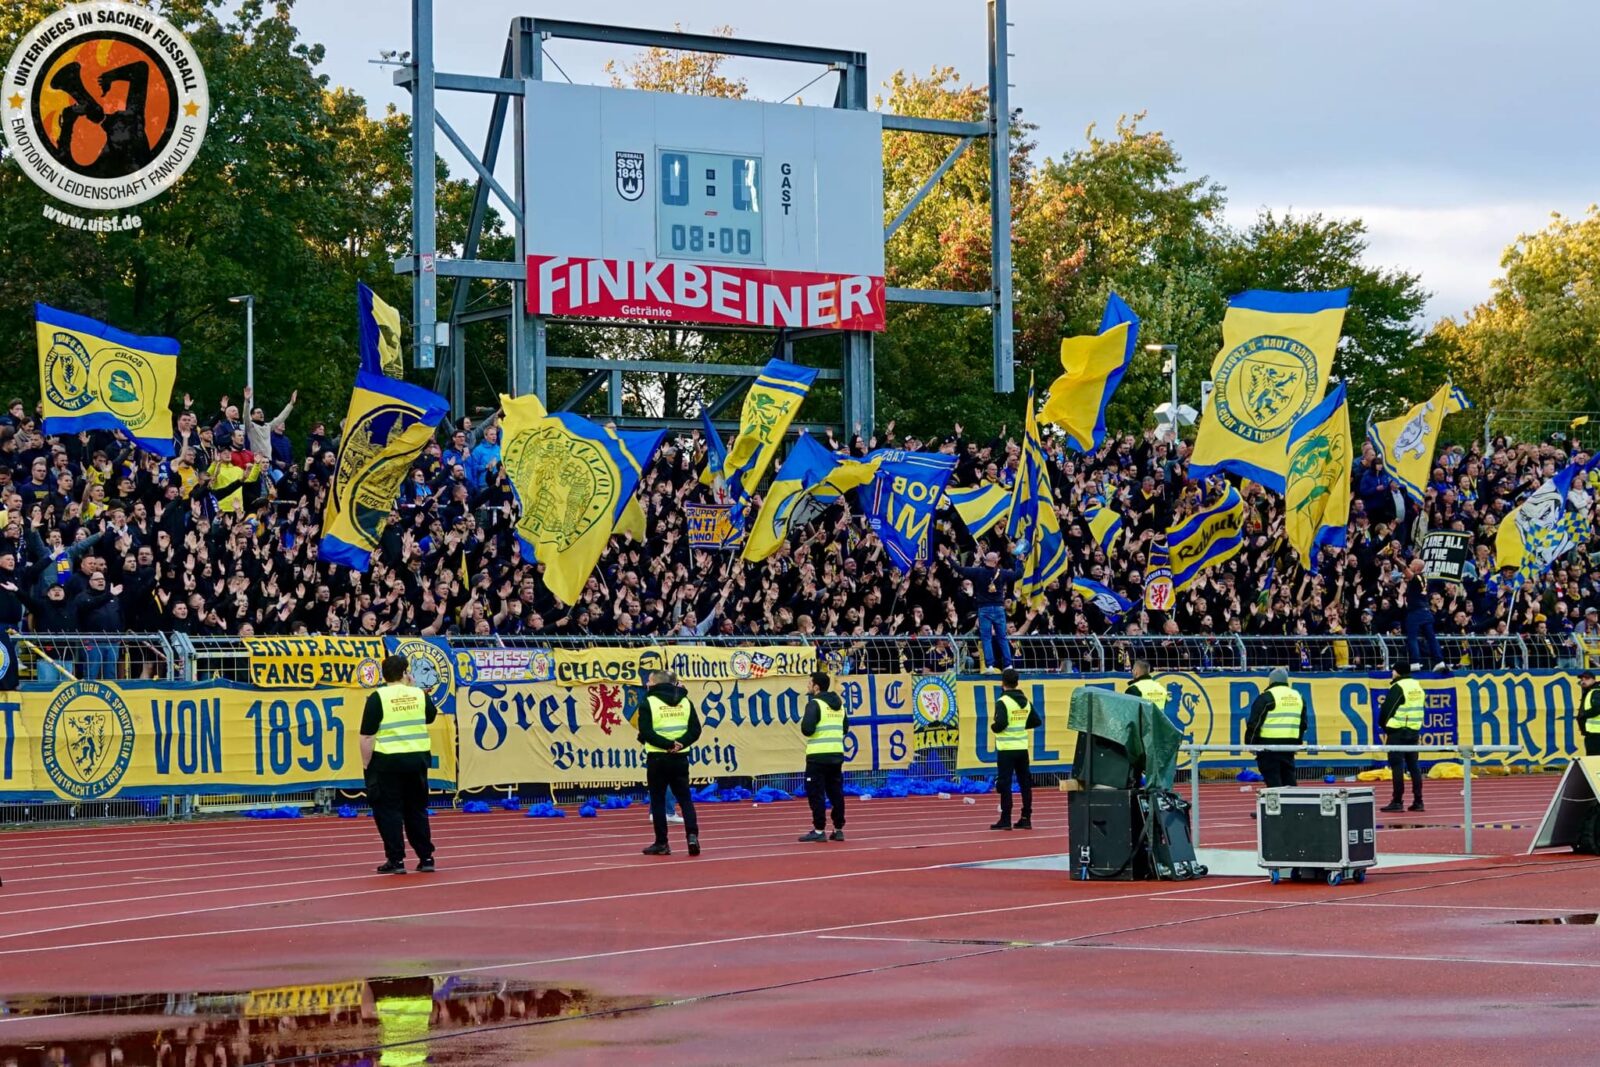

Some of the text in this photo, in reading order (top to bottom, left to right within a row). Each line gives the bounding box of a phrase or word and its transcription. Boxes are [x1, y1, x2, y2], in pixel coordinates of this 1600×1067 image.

[617, 158, 642, 170] SSV
[617, 168, 643, 179] 1846
[780, 163, 792, 215] GAST
[671, 224, 751, 255] 08:00
[539, 256, 874, 328] FINKBEINER
[621, 304, 672, 317] Getränke
[1444, 535, 1464, 549] ALL
[1430, 548, 1448, 560] THE
[248, 638, 382, 658] EINTRACHT
[474, 650, 530, 667] EXZESS
[252, 662, 314, 684] FANS
[319, 661, 356, 683] BW
[479, 667, 526, 681] BOYS
[557, 661, 636, 682] CHAOS
[671, 652, 817, 679] Müden Aller
[43, 686, 77, 765] BRAUNSCHWEIGER
[79, 681, 100, 695] TURN
[111, 697, 133, 760] SPORTVEREIN
[468, 684, 581, 751] Frei
[701, 681, 813, 729] Staa
[151, 696, 222, 775] VON
[246, 696, 345, 775] 1895
[889, 729, 907, 761] 8
[913, 729, 960, 752] HARZ
[51, 766, 90, 796] EINTRACHT
